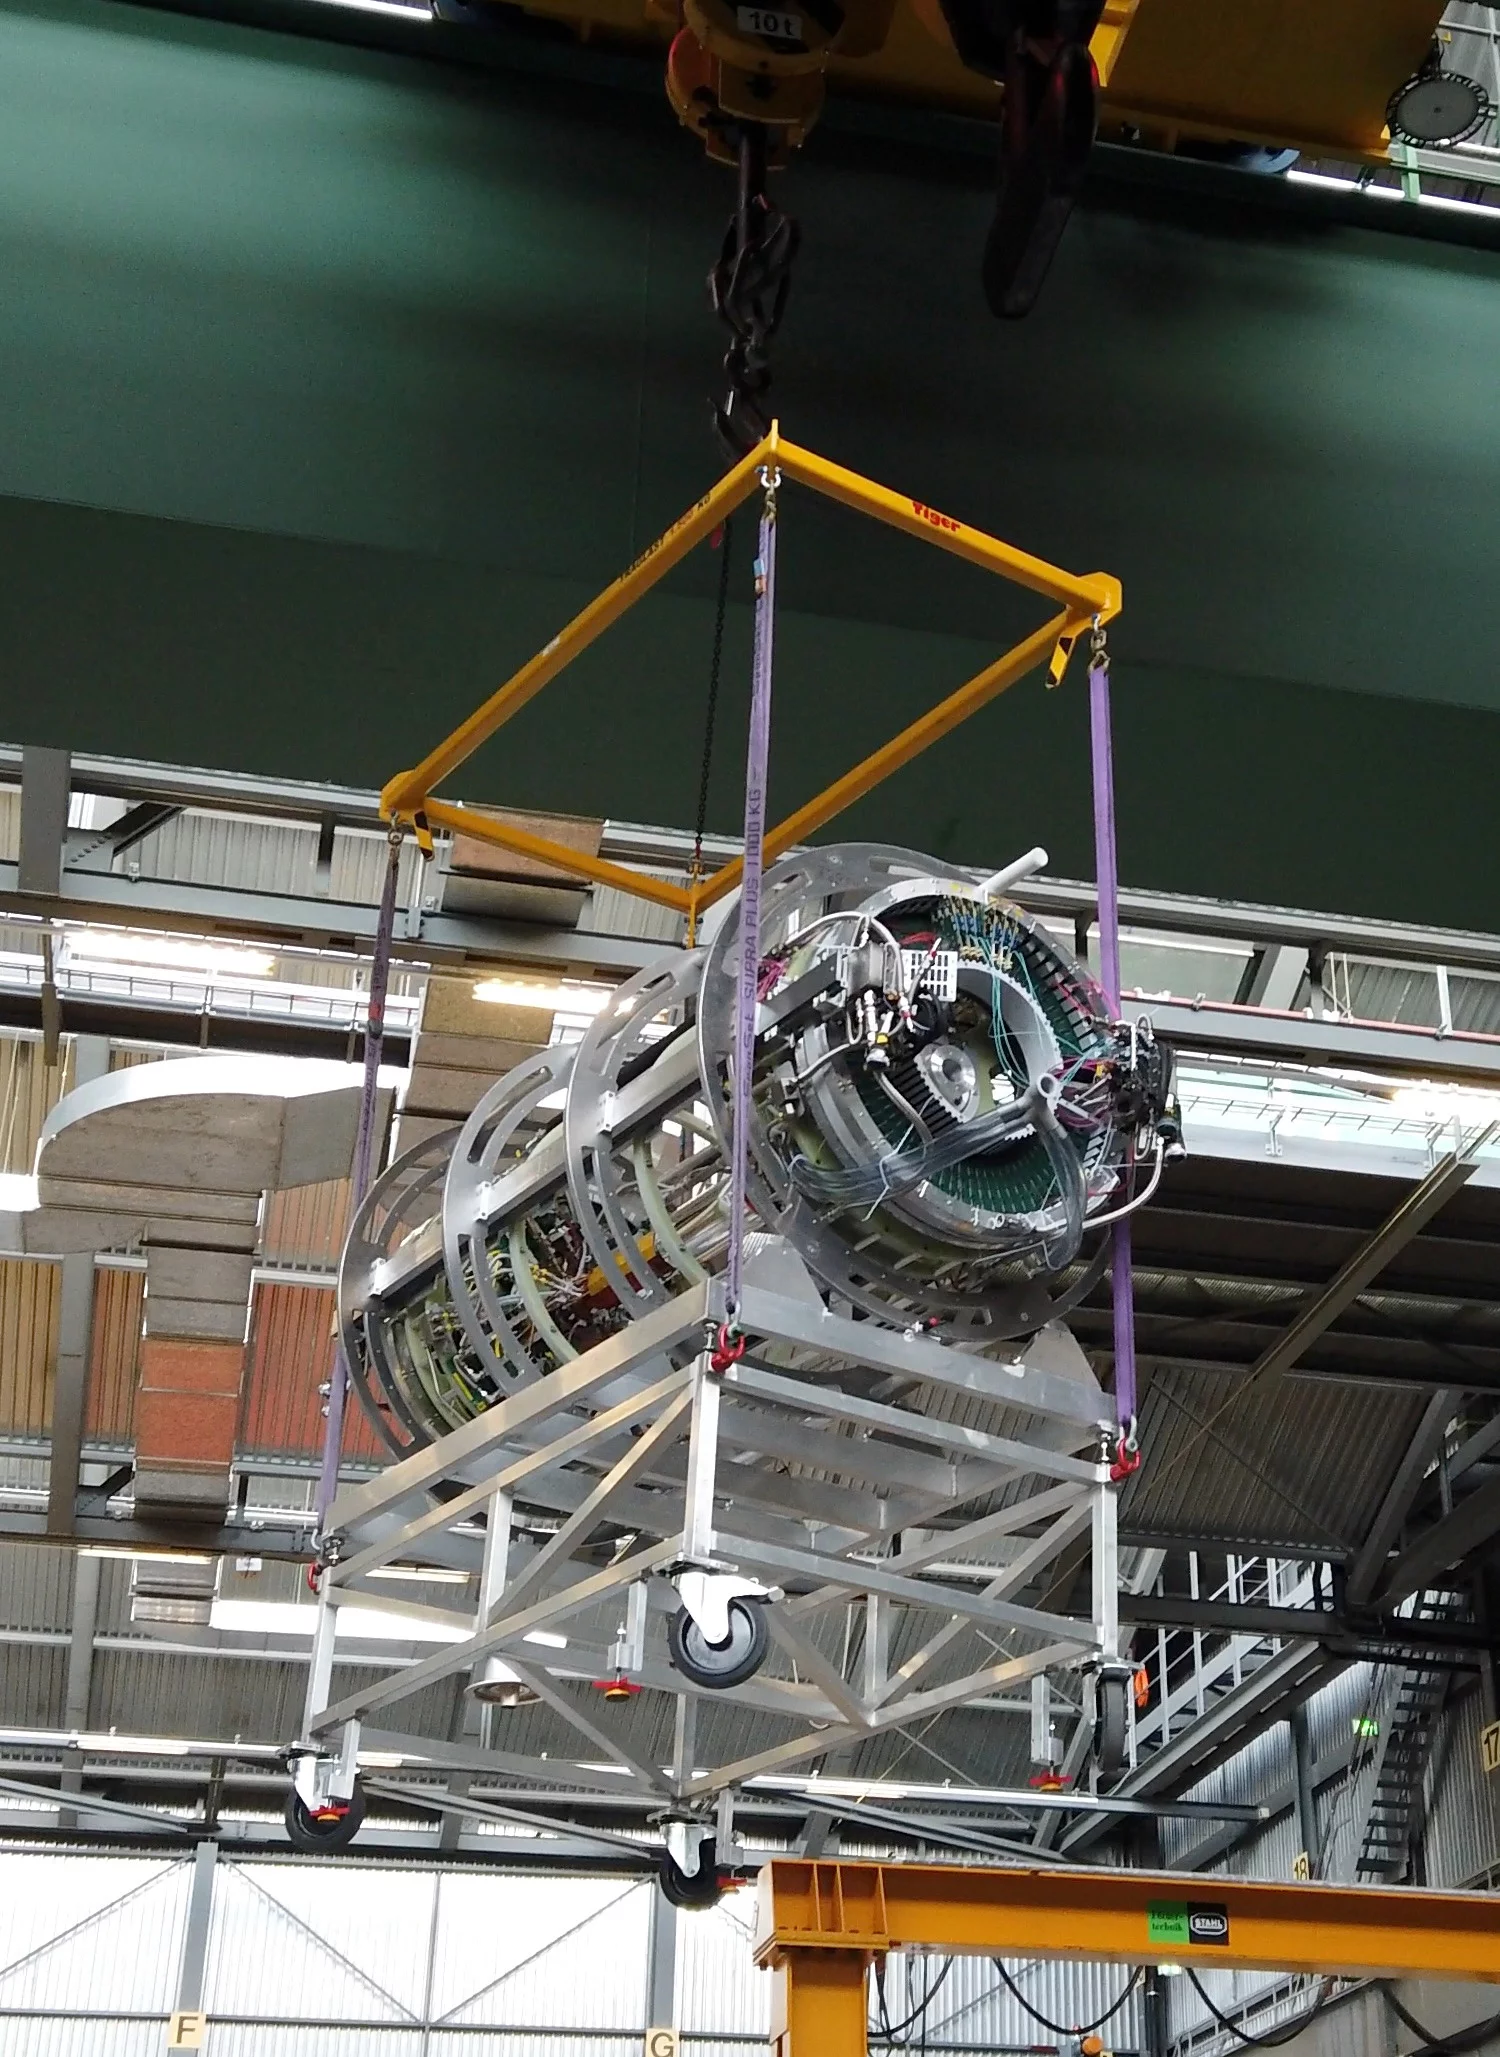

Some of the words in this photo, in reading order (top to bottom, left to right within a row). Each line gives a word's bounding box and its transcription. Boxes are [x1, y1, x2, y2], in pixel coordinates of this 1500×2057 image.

[749, 12, 779, 33] 10
[784, 17, 795, 37] t
[748, 788, 761, 815] KG
[746, 821, 760, 866] 1000
[745, 878, 759, 928] PLUS
[744, 935, 757, 1001] SUPRA
[1483, 1727, 1500, 1766] 17
[1294, 1857, 1308, 1881] 18
[1194, 1917, 1223, 1930] STAHL
[176, 2015, 199, 2044] F
[650, 2032, 674, 2057] G
